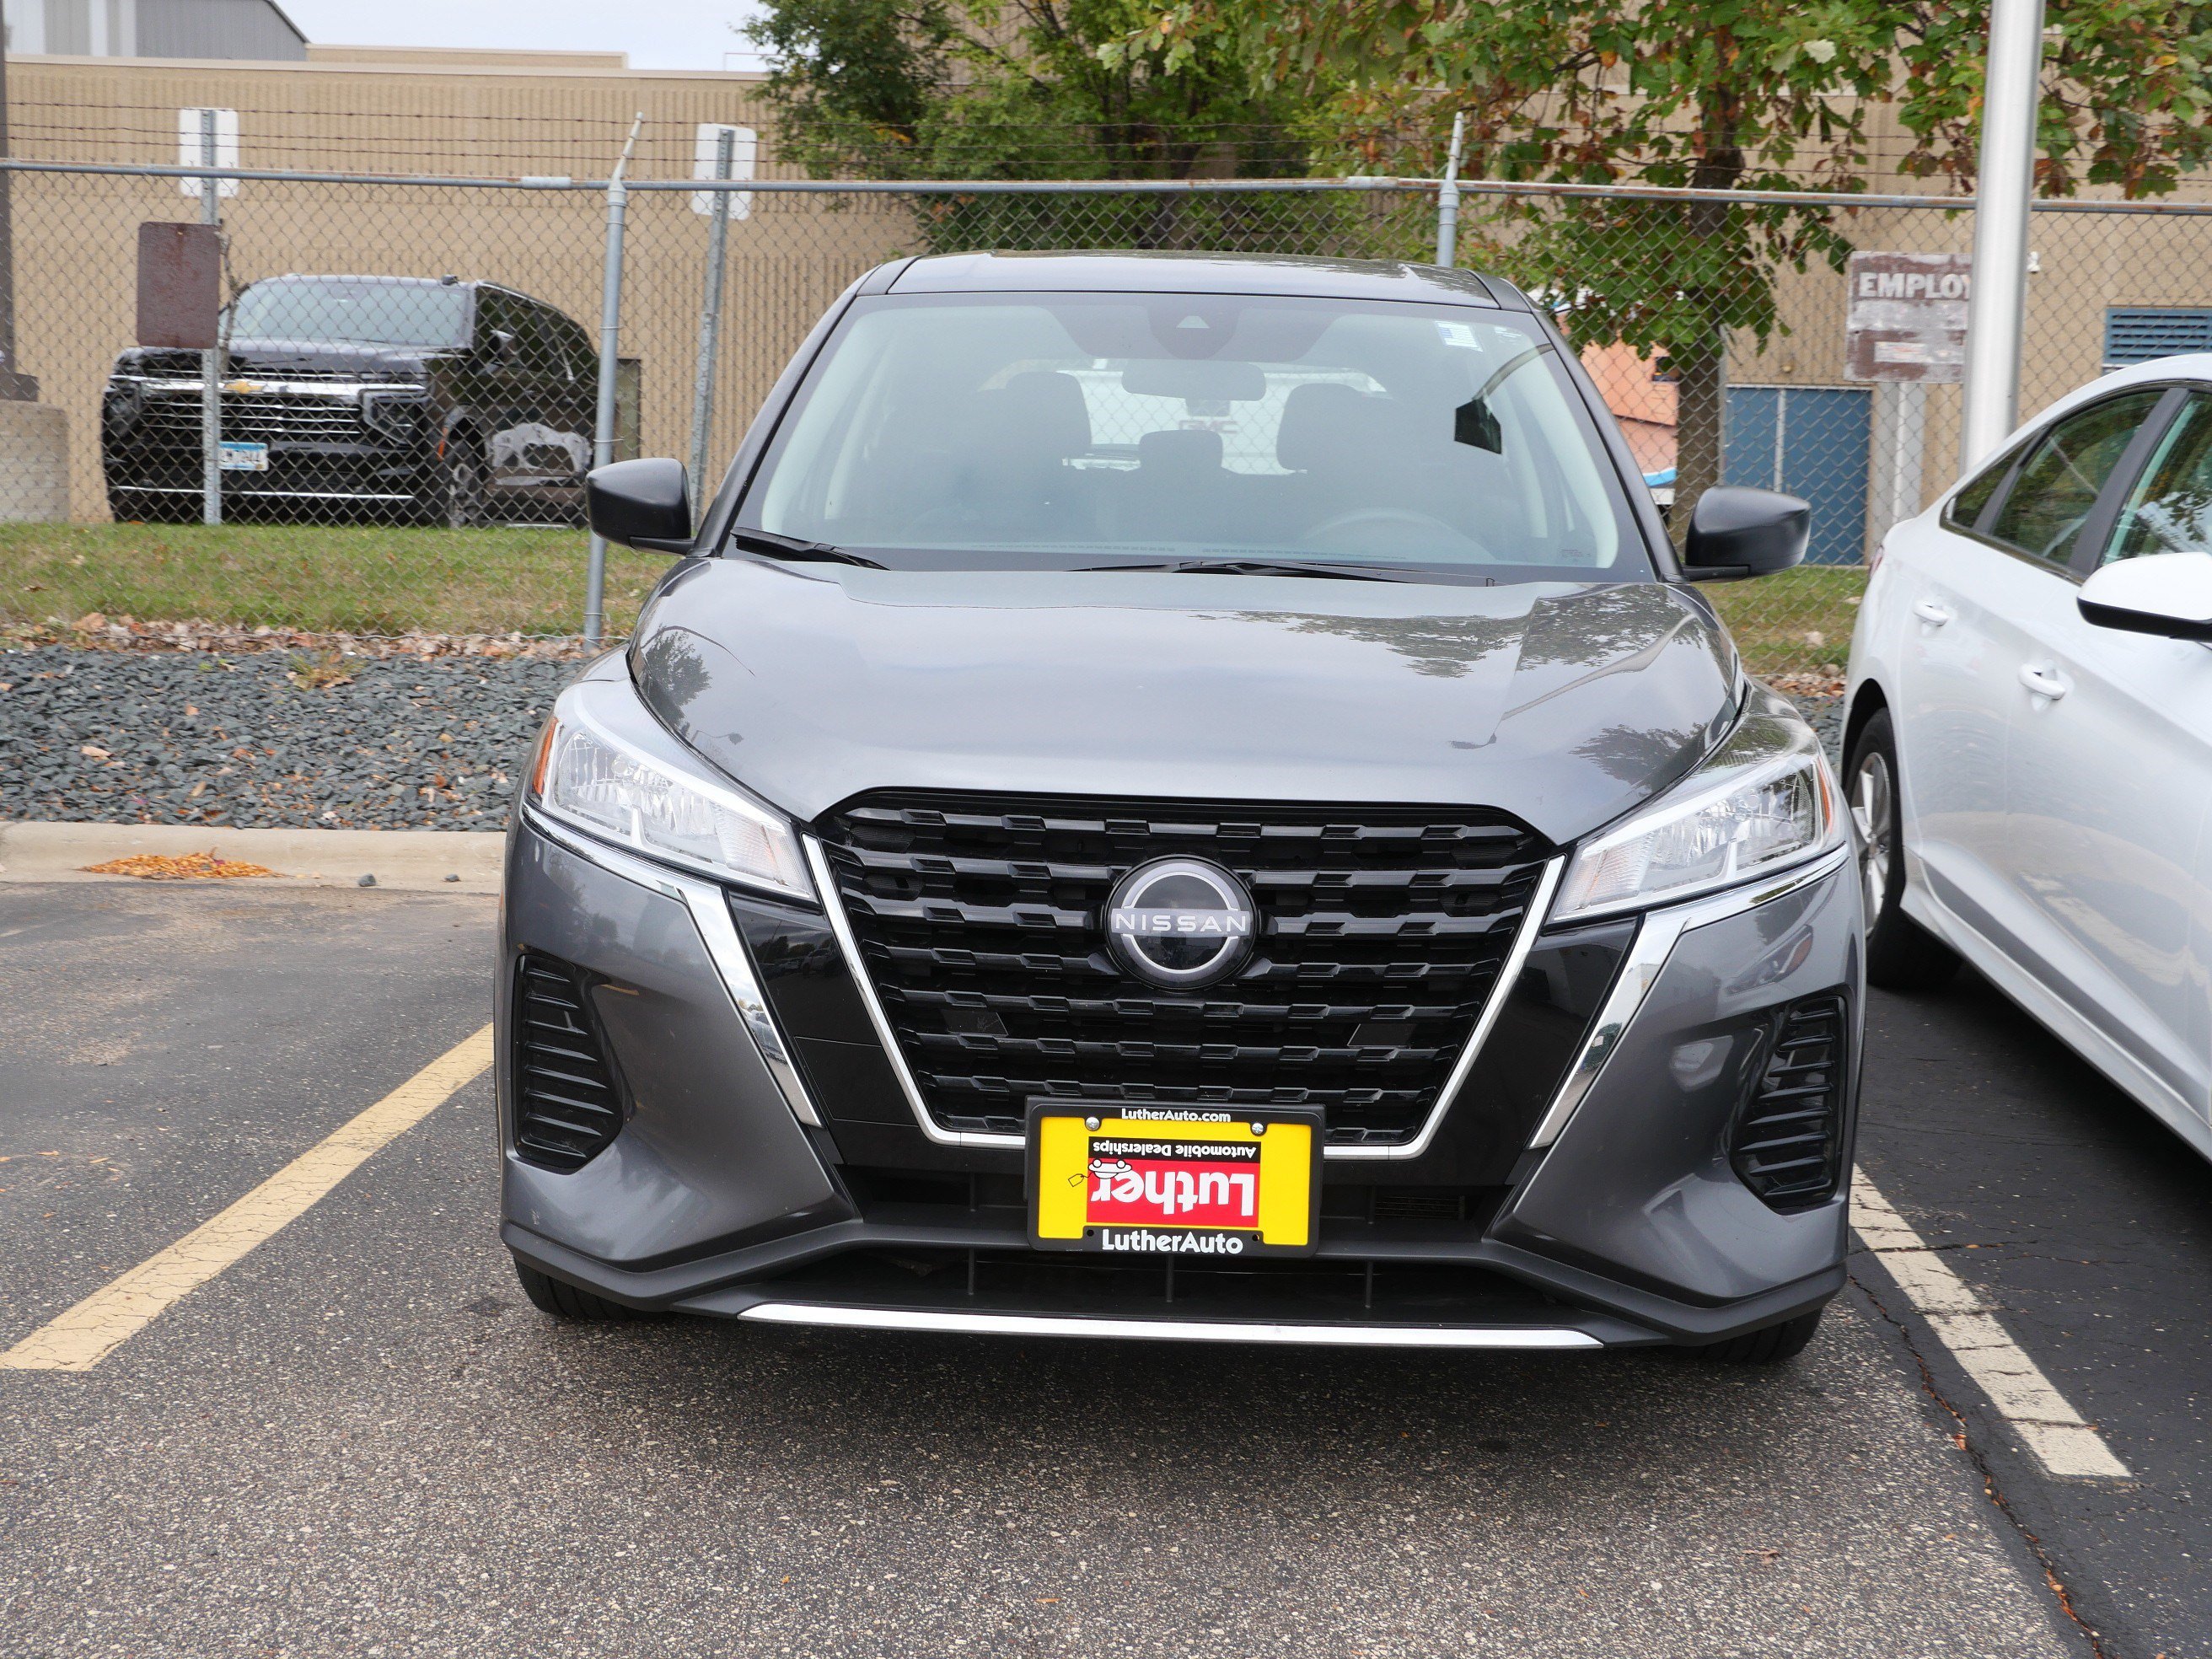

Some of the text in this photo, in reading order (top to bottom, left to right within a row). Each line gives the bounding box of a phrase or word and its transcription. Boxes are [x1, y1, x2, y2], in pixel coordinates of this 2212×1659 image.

[1115, 913, 1246, 932] NISSAN
[1121, 1108, 1232, 1123] LutherAuto.com
[1093, 1139, 1257, 1159] Automobile Dealerships
[1090, 1169, 1255, 1216] Luther
[1102, 1228, 1243, 1254] LutherAuto
